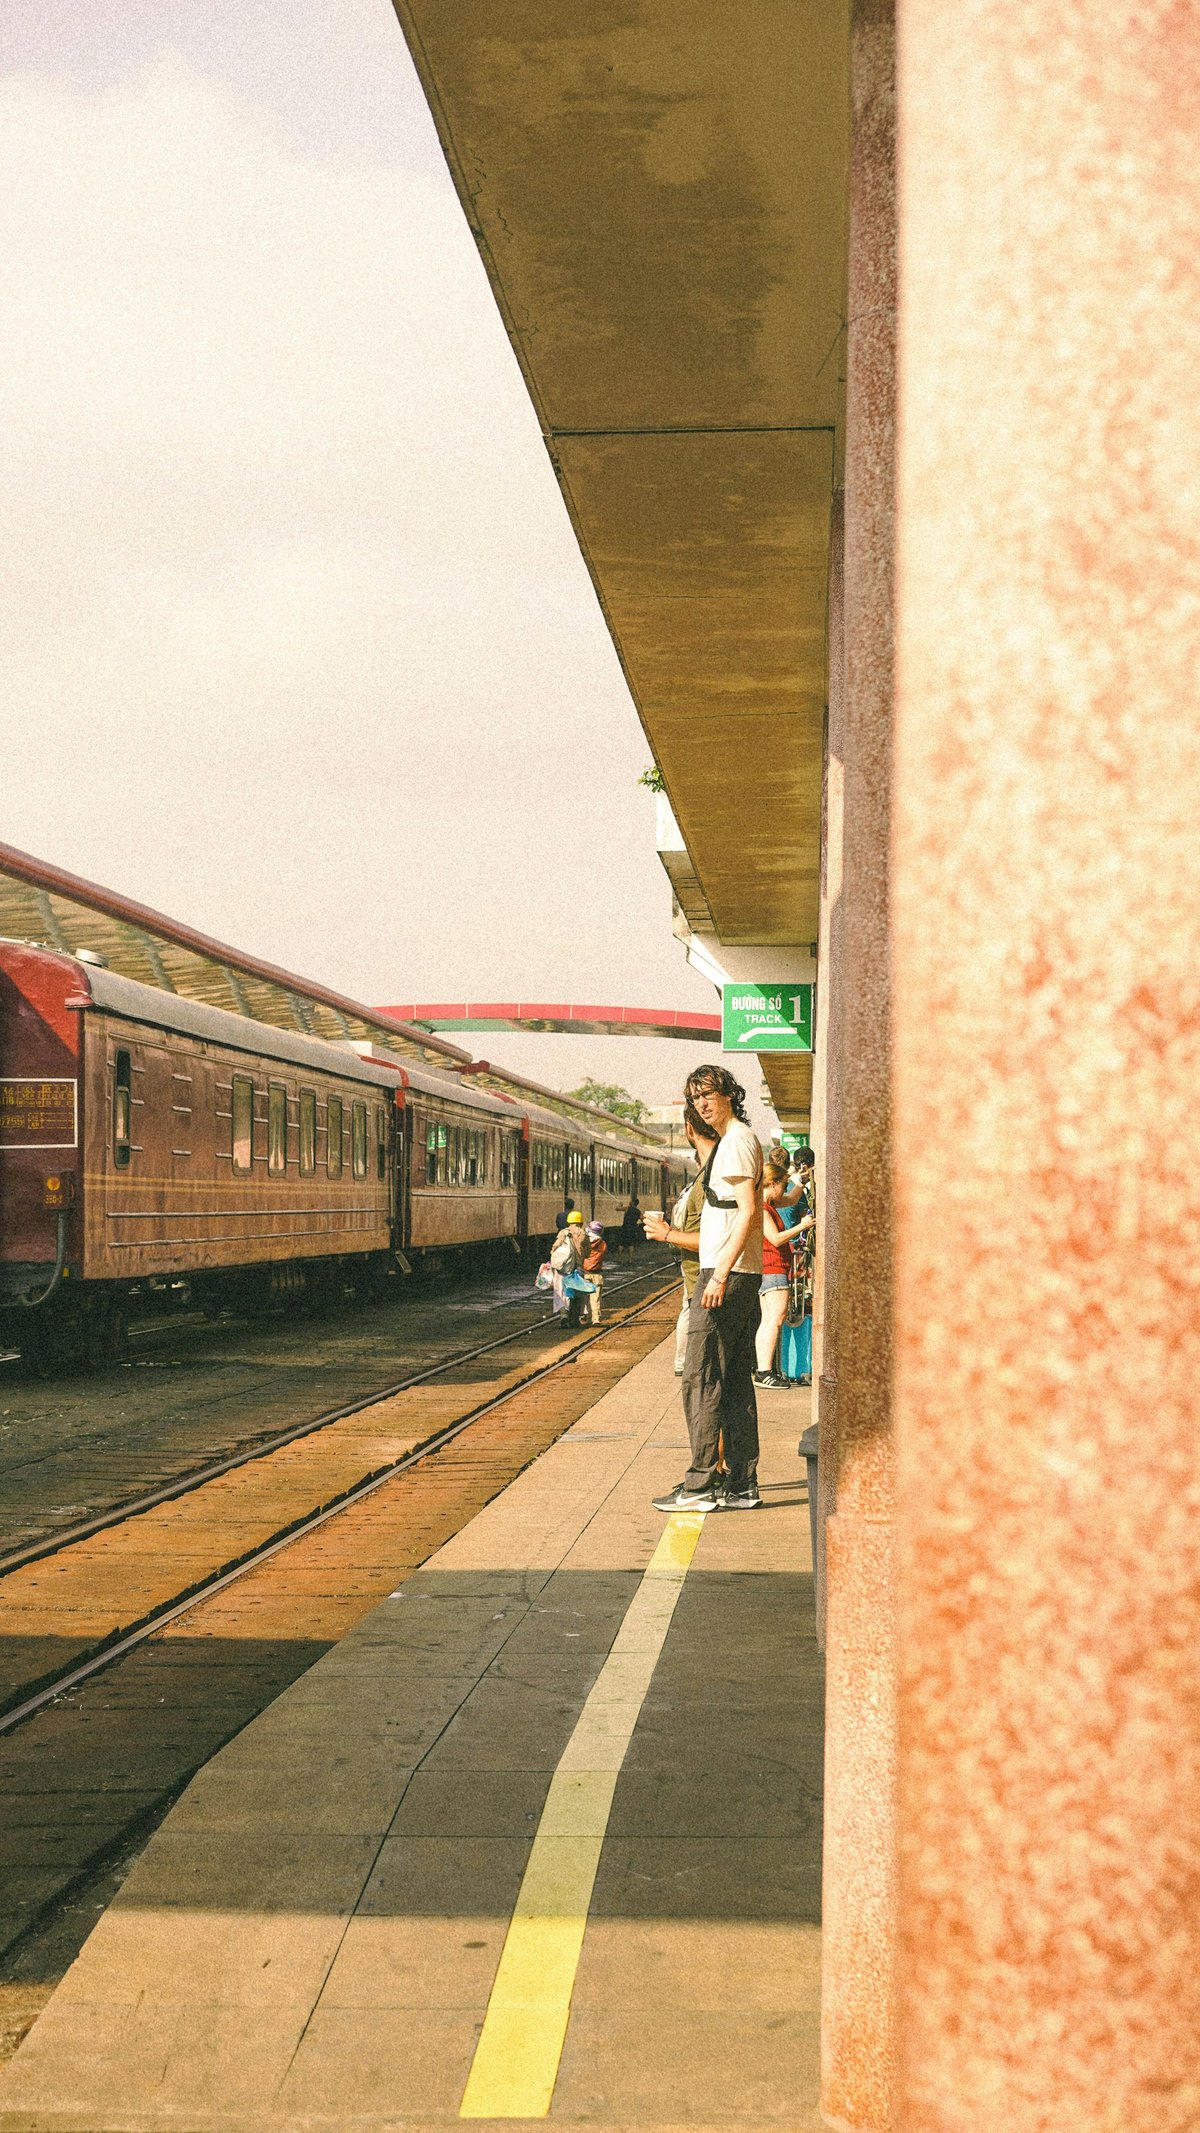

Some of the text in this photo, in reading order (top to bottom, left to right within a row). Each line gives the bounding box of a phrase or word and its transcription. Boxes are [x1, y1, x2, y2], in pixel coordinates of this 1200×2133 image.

[731, 992, 806, 1024] ĐƯỜNG SỐ 1
[744, 1014, 782, 1024] TRACK
